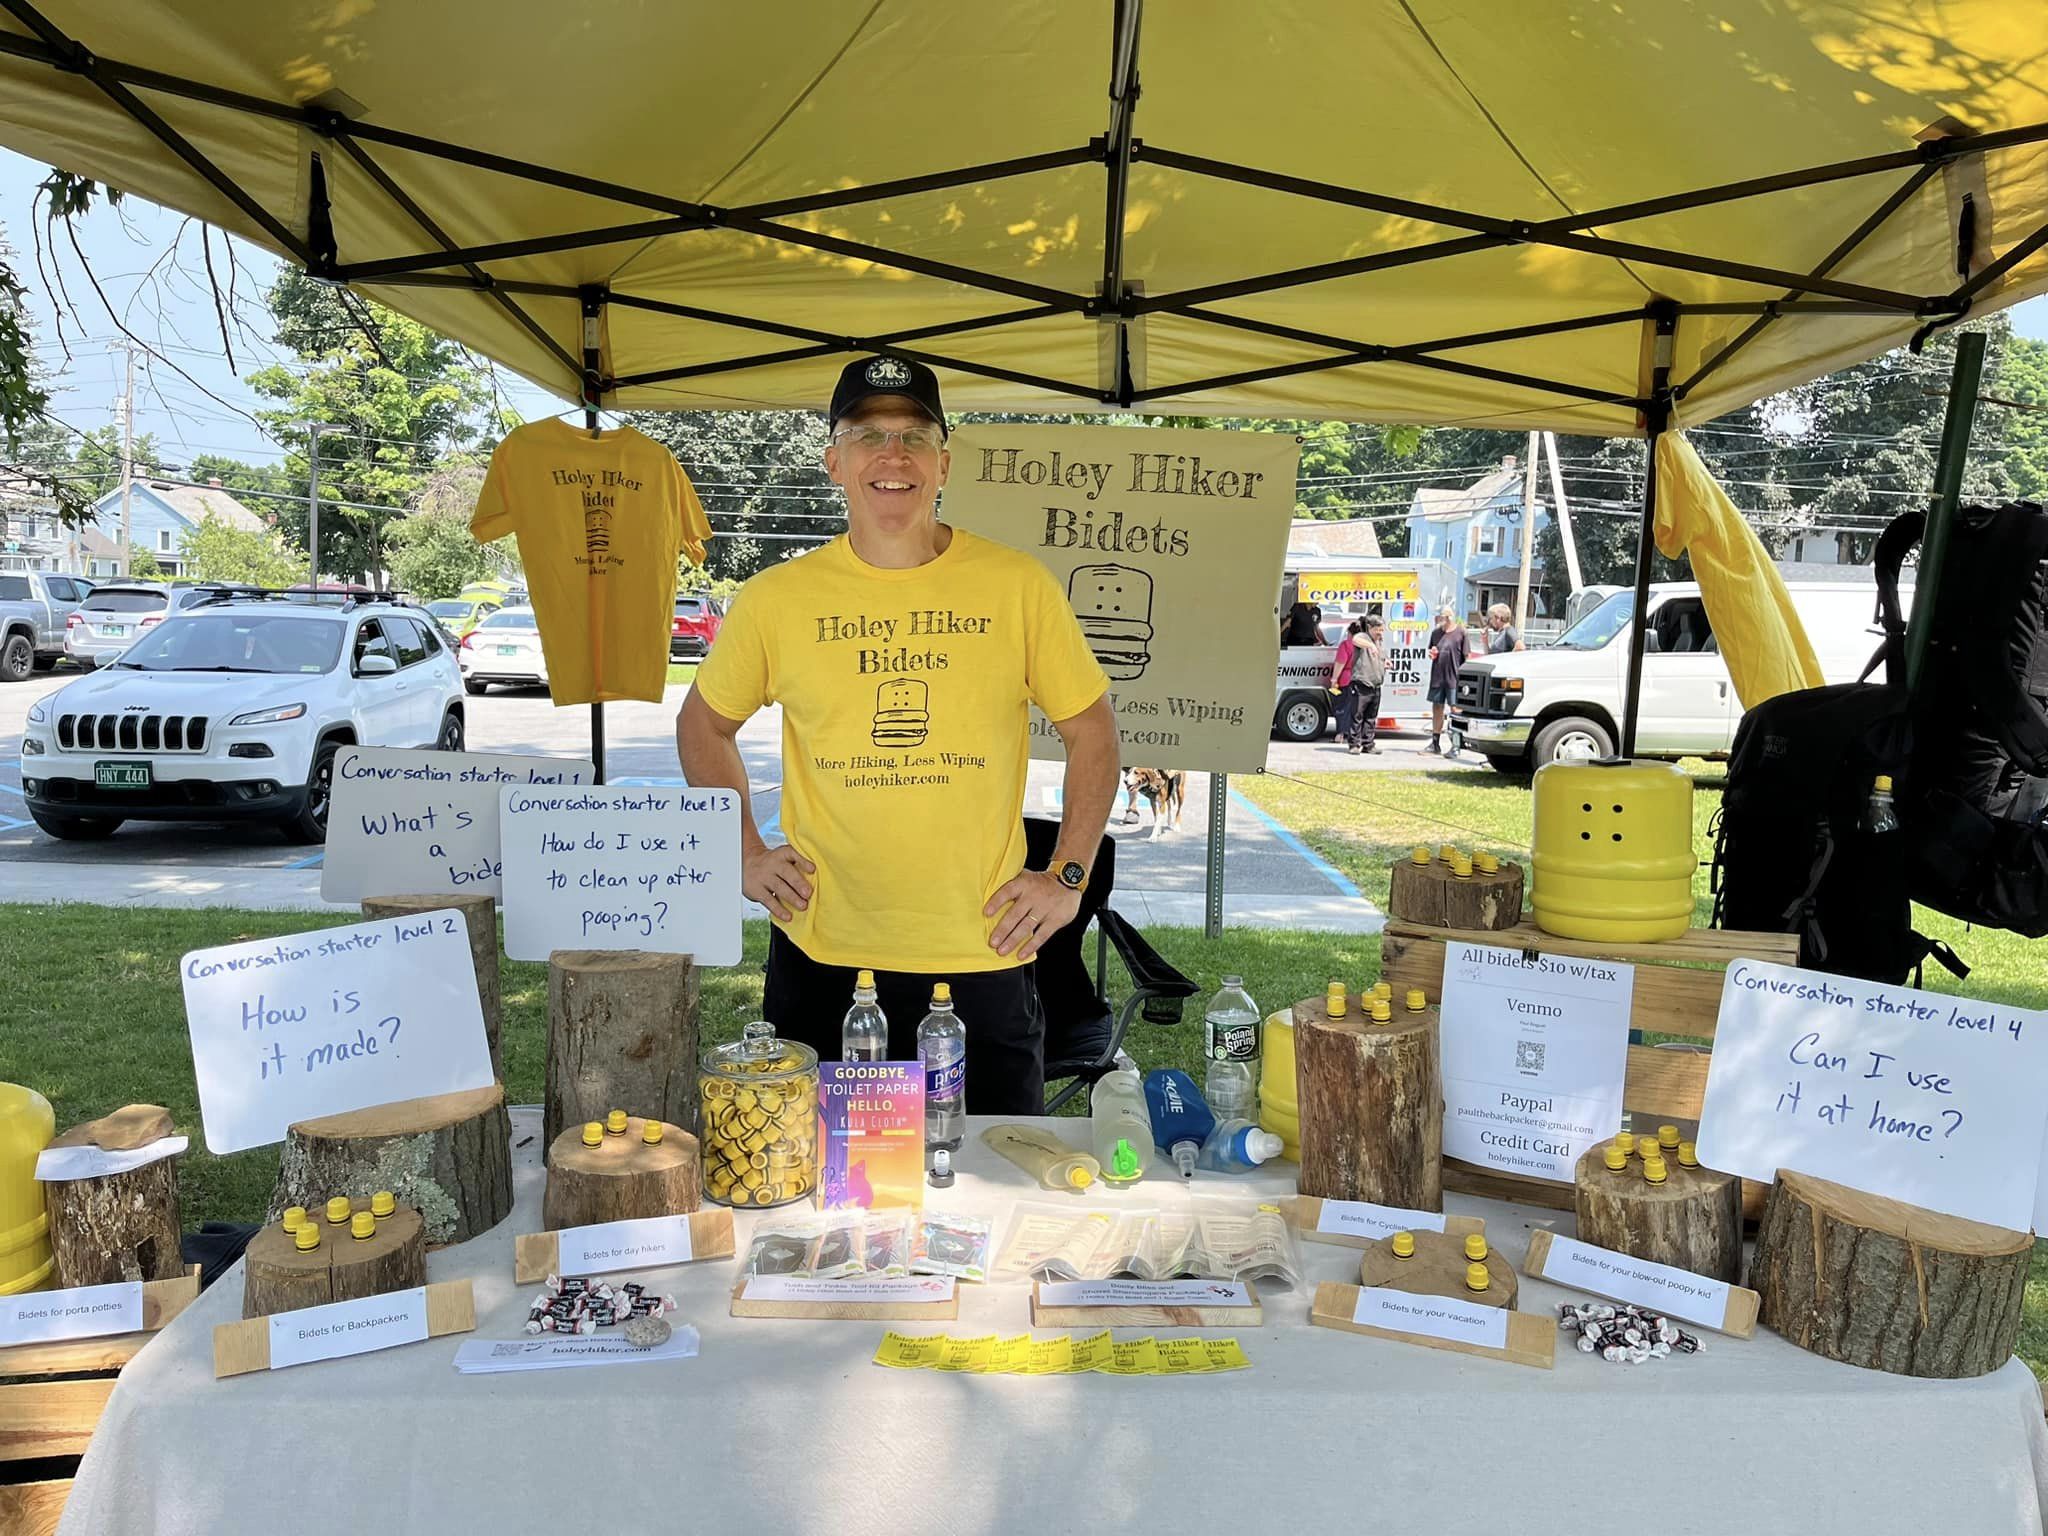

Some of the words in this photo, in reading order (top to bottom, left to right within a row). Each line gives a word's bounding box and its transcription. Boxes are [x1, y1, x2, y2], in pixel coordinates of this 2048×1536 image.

[976, 447, 1113, 500] Holey
[1126, 452, 1264, 500] Hiker
[1038, 506, 1189, 557] Bidets
[1310, 590, 1404, 602] COPSICLE
[815, 615, 898, 643] Holey
[908, 610, 991, 635] Hiker
[856, 648, 948, 675] Bidets
[1277, 667, 1333, 677] ENNINGTO
[1390, 672, 1420, 683] TOS
[124, 704, 150, 712] Jeep
[1110, 693, 1160, 715] Less
[1166, 697, 1245, 725] Wiping
[340, 753, 452, 783] Conversation
[459, 766, 516, 784] starter
[528, 768, 563, 784] level
[572, 773, 581, 784] 1
[815, 756, 845, 770] More
[849, 755, 899, 771] Hiking,
[903, 754, 936, 767] Less
[939, 752, 986, 769] Wiping
[99, 768, 118, 784] HNY
[125, 770, 144, 783] 444
[845, 773, 950, 790] holeyhiker.com
[509, 790, 608, 813] Conversation
[612, 792, 672, 813] starter
[679, 794, 717, 812] level
[720, 797, 732, 812] 3
[361, 803, 473, 836] What's
[429, 843, 446, 857] a
[541, 832, 575, 855] How
[583, 831, 605, 850] do
[615, 833, 632, 850] I
[640, 838, 668, 851] use
[679, 833, 701, 850] it
[449, 858, 502, 885] bide
[546, 868, 568, 891] to
[578, 868, 628, 889] clean
[638, 876, 659, 894] up
[665, 864, 713, 886] after
[581, 901, 669, 937] pooping?
[187, 949, 311, 979] Conversation
[317, 932, 382, 957] starter
[394, 921, 434, 944] level
[442, 918, 458, 934] 2
[1462, 949, 1484, 963] All
[1538, 958, 1566, 974] $10
[1569, 960, 1618, 981] w/tax
[241, 995, 308, 1030] How
[331, 990, 362, 1014] is
[1506, 998, 1563, 1019] Venmo
[1733, 967, 1854, 1008] Conversation
[1865, 995, 1940, 1020] starter
[1947, 1007, 1996, 1033] level
[2008, 1021, 2024, 1040] 4
[260, 1043, 287, 1079] it
[306, 1016, 401, 1072] made?
[1224, 1025, 1255, 1046] Poland
[834, 1067, 909, 1080] GOODBYE,
[1788, 1033, 1847, 1072] Can
[1864, 1051, 1896, 1079] I
[1907, 1070, 1953, 1094] use
[825, 1083, 872, 1096] TOILET
[876, 1083, 918, 1095] PAPER
[847, 1100, 896, 1113] HELLO,
[1501, 1092, 1553, 1113] Paypal
[1457, 1107, 1594, 1136] paulthebackpacker@gmail.com
[1774, 1081, 1801, 1113] it
[1817, 1094, 1854, 1125] at
[1868, 1100, 1963, 1159] home?
[1480, 1130, 1529, 1152] Credit
[1532, 1138, 1570, 1158] Card
[1488, 1151, 1555, 1172] holeyhiker.com
[1366, 1218, 1377, 1226] for
[583, 1249, 609, 1260] Bidets
[611, 1248, 622, 1257] for
[624, 1246, 639, 1256] day
[641, 1244, 666, 1253] hikers
[1571, 1252, 1597, 1268] Bidets
[1599, 1261, 1611, 1270] for
[1611, 1265, 1631, 1276] your
[1632, 1270, 1667, 1286] blow-out
[1667, 1281, 1696, 1296] poopy
[1697, 1288, 1711, 1299] kid
[18, 1310, 48, 1320] Bidets
[50, 1307, 62, 1317] for
[65, 1305, 90, 1316] porta
[91, 1301, 123, 1313] potties
[1382, 1301, 1409, 1313] Bidets
[1411, 1307, 1423, 1315] for
[1424, 1310, 1445, 1320] your
[1447, 1314, 1486, 1326] vacation
[298, 1327, 329, 1340] Bidets
[331, 1323, 344, 1334] for
[347, 1311, 409, 1331] Backpackers
[551, 1346, 652, 1354] holeyhiker.com
